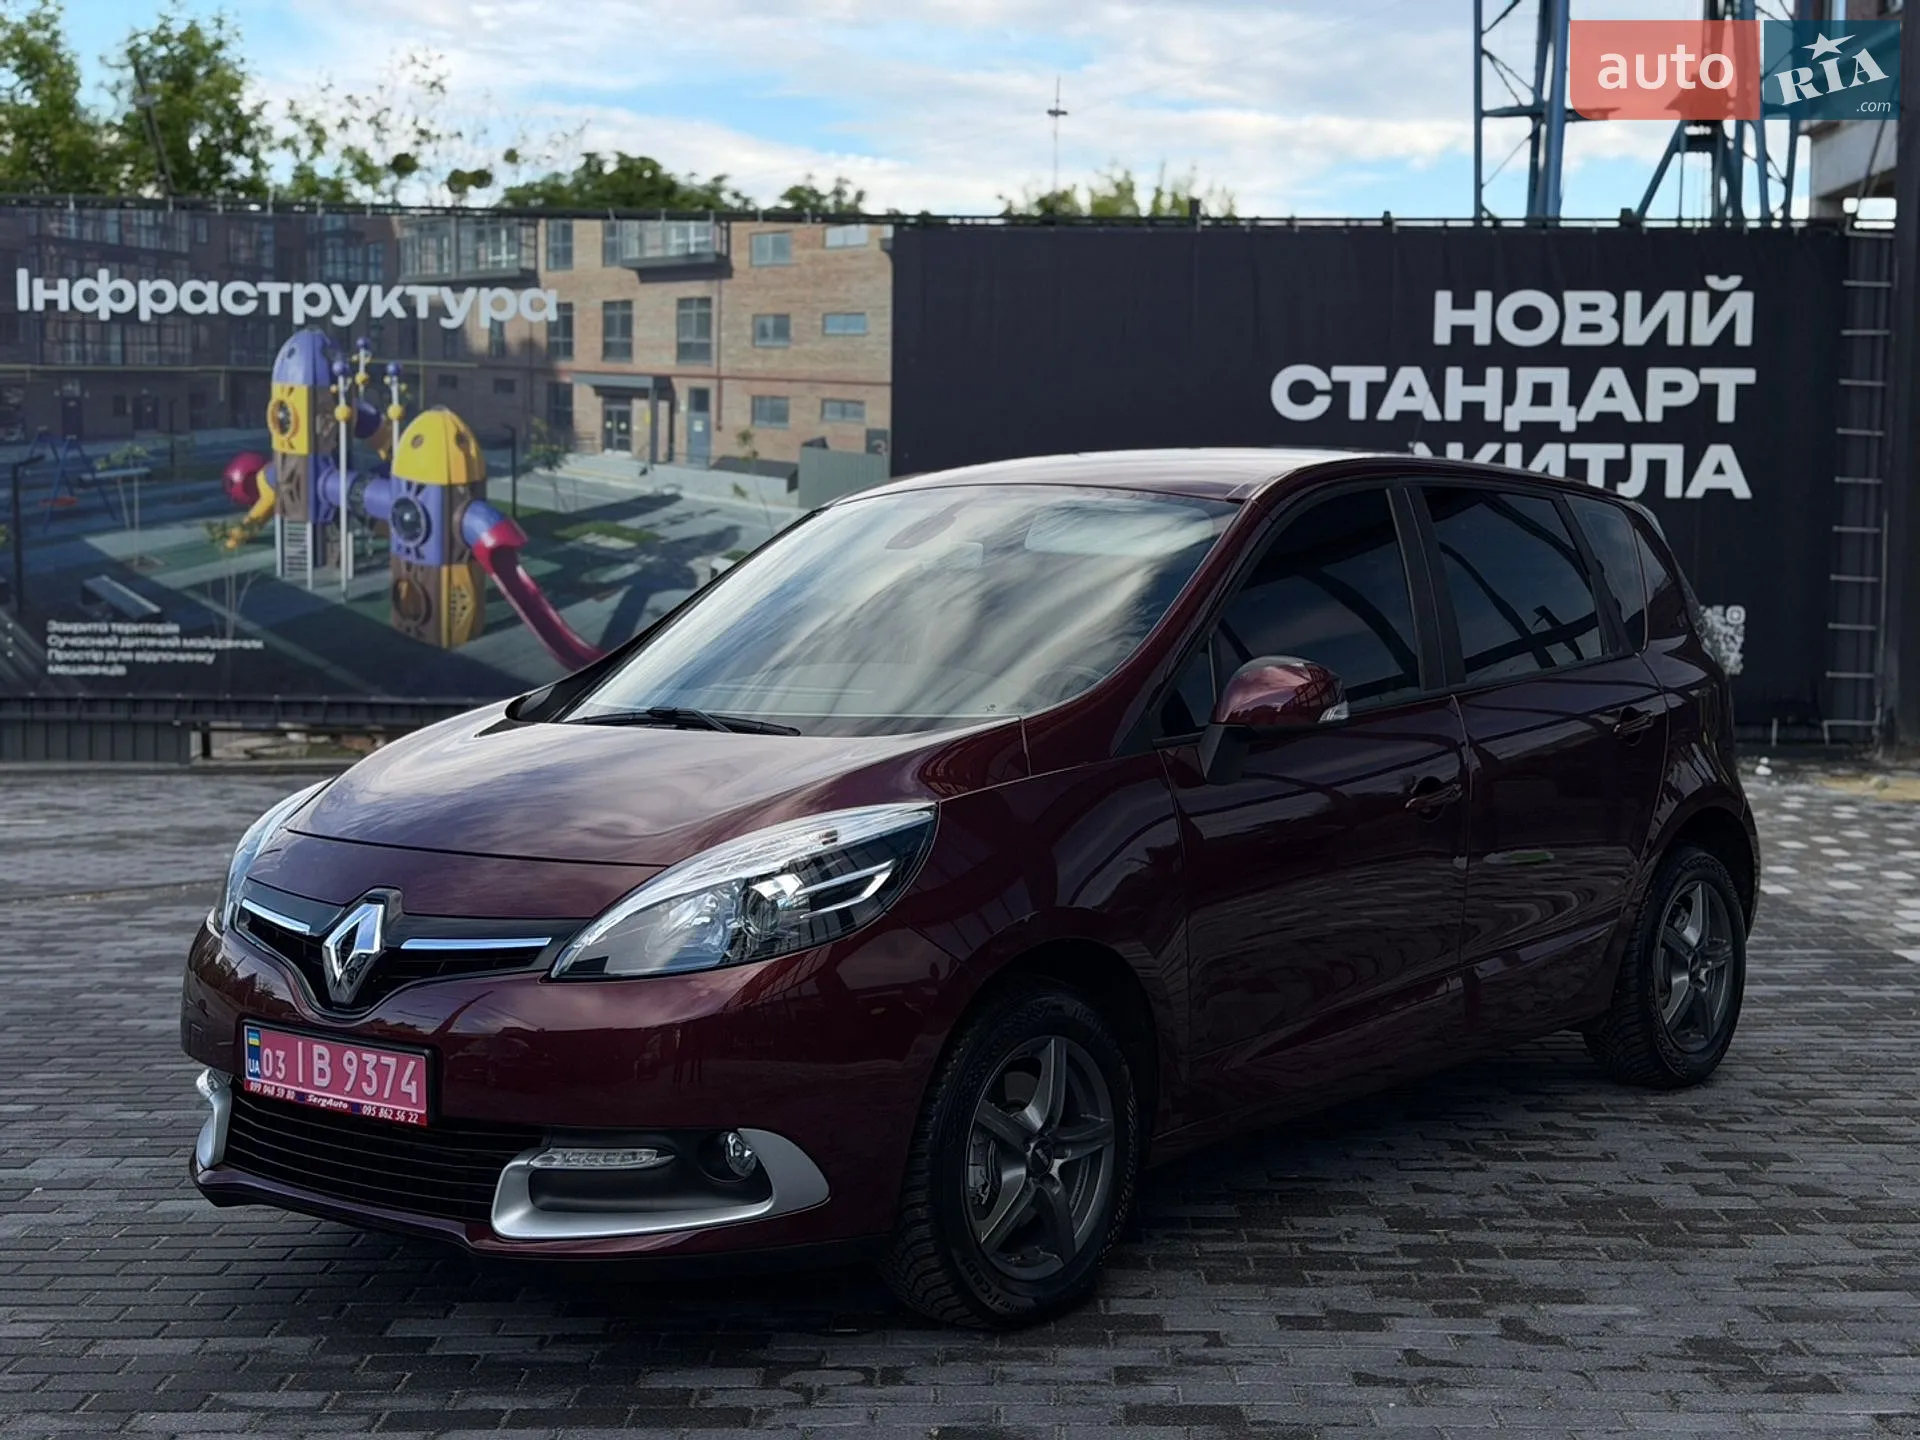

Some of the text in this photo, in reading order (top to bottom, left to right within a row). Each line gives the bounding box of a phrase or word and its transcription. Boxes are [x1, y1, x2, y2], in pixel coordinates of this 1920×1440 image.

[16, 267, 558, 330] Інфраструктура
[1433, 275, 1754, 347] НОВИЙ
[1270, 364, 1756, 433] СТАНДАРТ
[1411, 442, 1751, 499] ИТЛА
[248, 1058, 260, 1074] UA
[262, 1048, 286, 1080] 03
[342, 1050, 418, 1104] 9374
[306, 1094, 349, 1110] SergAuto
[362, 1106, 419, 1124] 095 862 56 22
